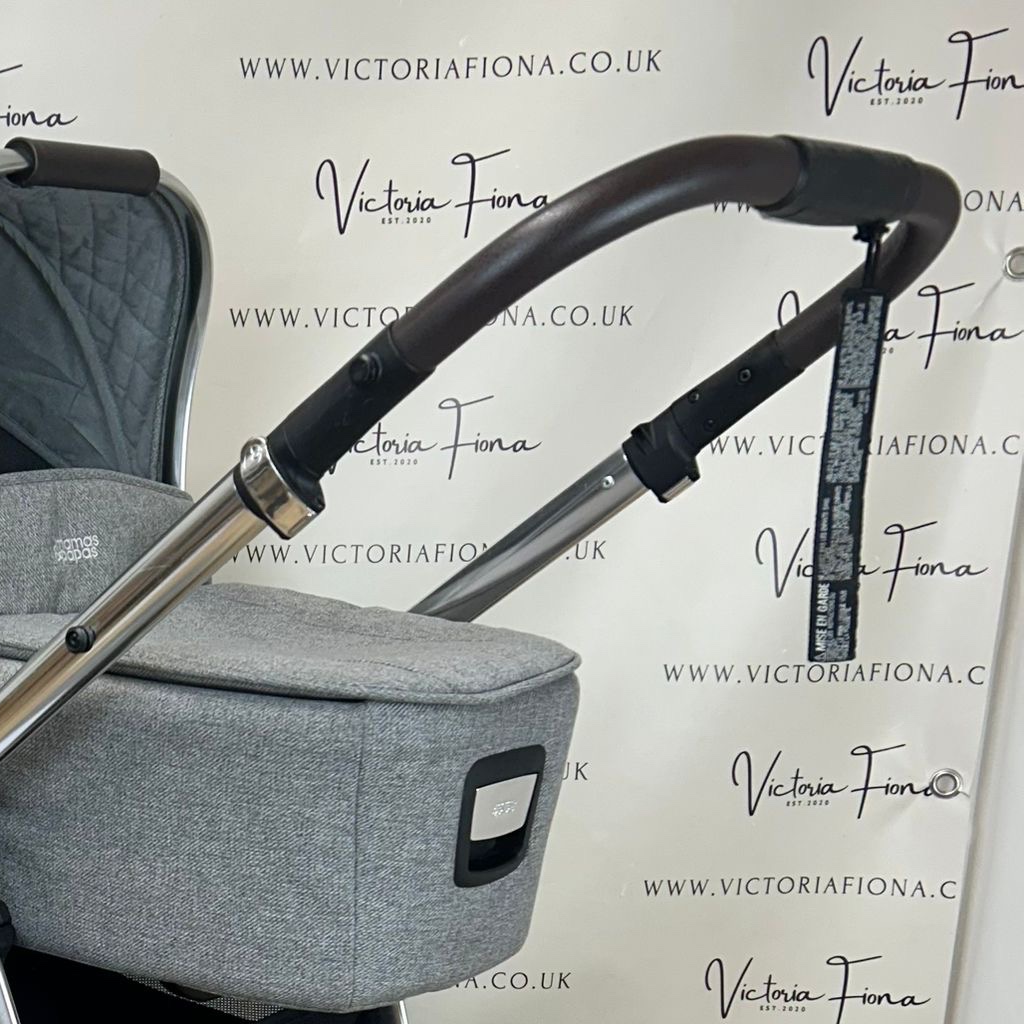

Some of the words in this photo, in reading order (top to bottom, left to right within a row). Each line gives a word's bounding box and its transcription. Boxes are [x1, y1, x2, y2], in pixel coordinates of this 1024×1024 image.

[239, 49, 662, 81] WWW.VICTORIAFIONA.CO.UK
[808, 36, 946, 117] Victoria
[948, 28, 1024, 120] Fion
[870, 97, 923, 106] EST.2020
[315, 158, 451, 235] Victoria
[451, 148, 549, 238] Fiona
[229, 304, 634, 328] WWW.VICTONA.CO.UK
[918, 282, 1024, 370] Fiona
[438, 395, 542, 480] Fiona
[883, 521, 988, 603] Fiona
[663, 662, 986, 686] WWW.VICTORIAFIONA.C
[731, 750, 849, 816] Victoria
[643, 876, 957, 899] WWW.VICTORIAFIONA.C
[456, 971, 571, 990] A.CO.UK
[704, 957, 825, 1019] Victoria
